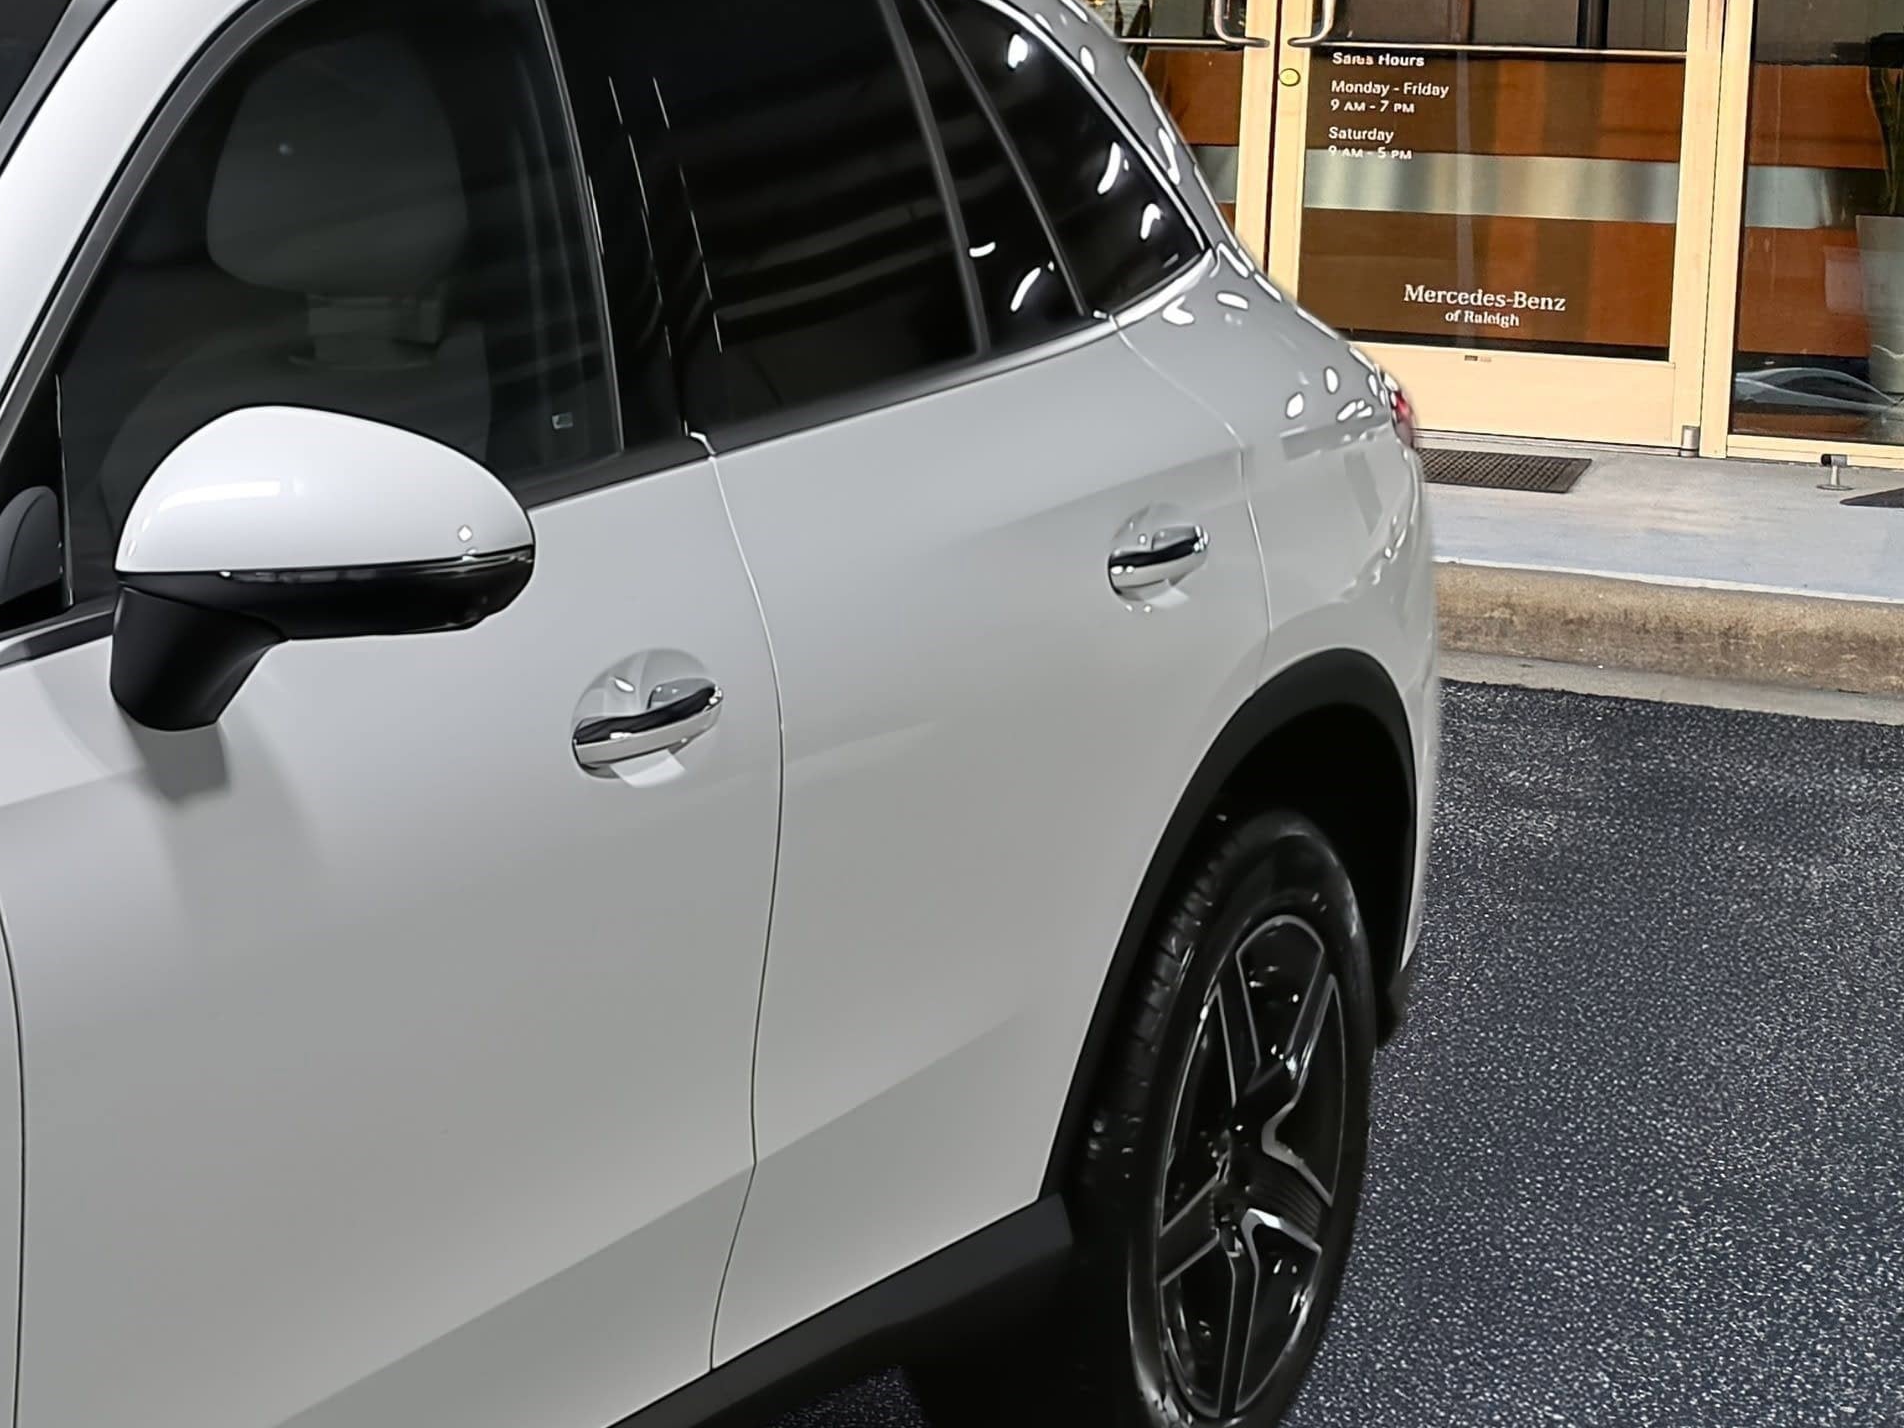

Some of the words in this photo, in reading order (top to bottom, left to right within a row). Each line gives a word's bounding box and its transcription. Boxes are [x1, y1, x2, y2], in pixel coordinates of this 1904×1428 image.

[1378, 53, 1425, 67] Hours
[1331, 80, 1390, 97] Monday
[1403, 82, 1450, 99] Friday
[1330, 98, 1340, 111] 9
[1343, 102, 1366, 112] AM
[1379, 100, 1389, 112] 7
[1393, 103, 1415, 113] PM
[1328, 126, 1394, 144] Saturday
[1341, 148, 1364, 158] AM
[1377, 146, 1388, 158] 5
[1391, 150, 1413, 160] PM
[1403, 283, 1567, 312] Mercedes-Benz
[1444, 309, 1462, 322] of
